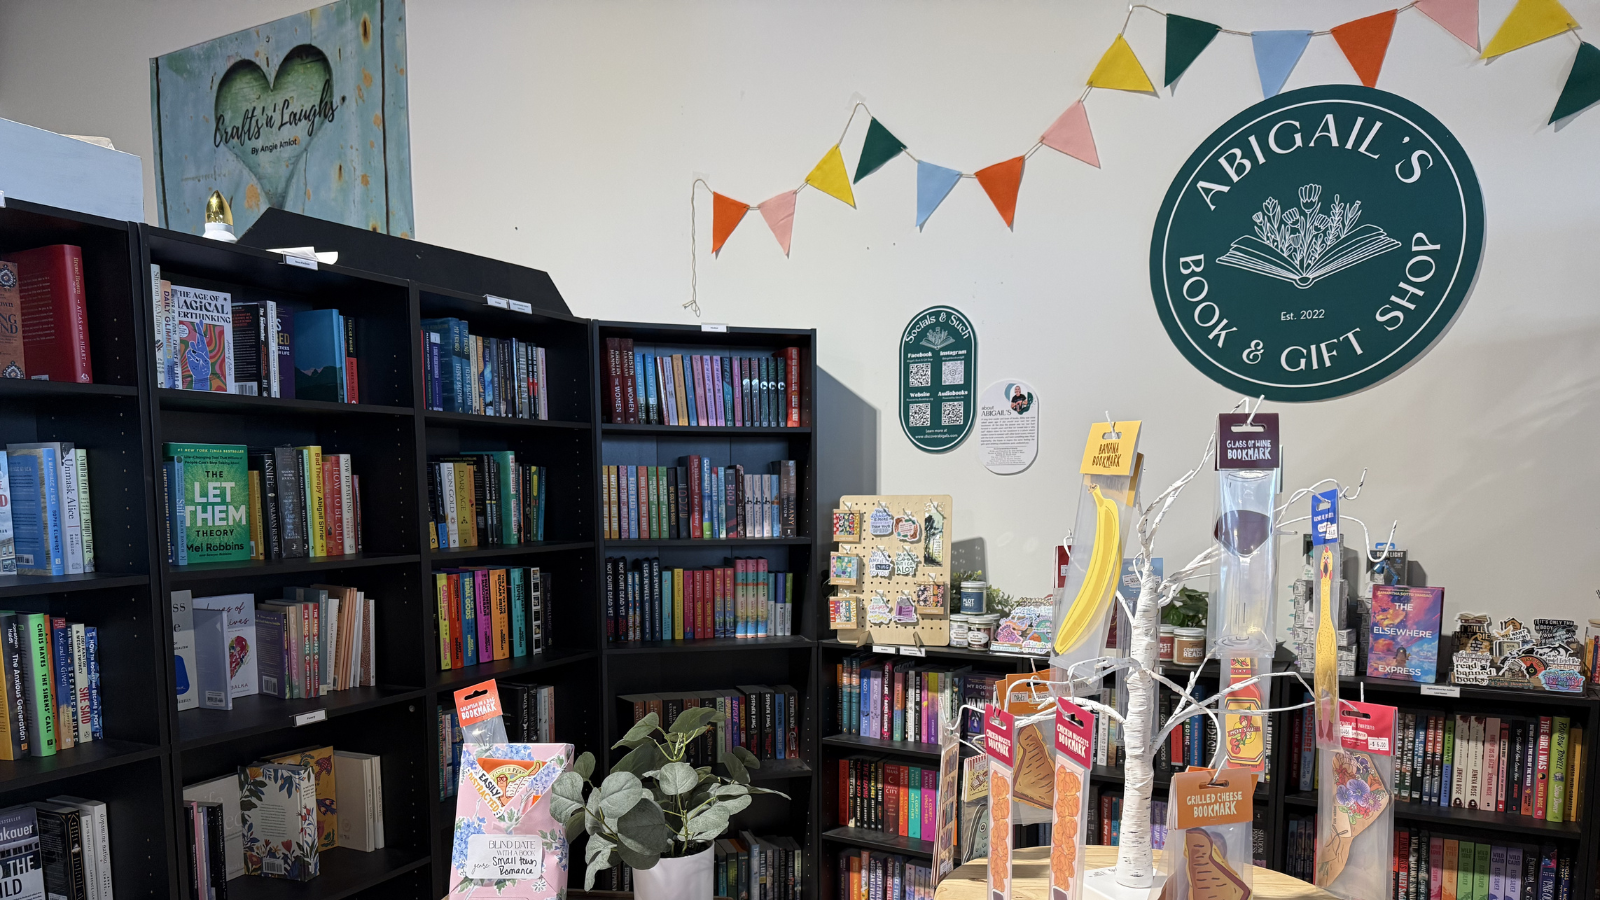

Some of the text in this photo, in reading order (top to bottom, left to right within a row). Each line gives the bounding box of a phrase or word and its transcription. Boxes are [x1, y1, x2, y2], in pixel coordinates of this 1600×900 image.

[251, 146, 259, 155] By
[260, 142, 278, 153] Angie
[1196, 113, 1433, 211] ABIGAIL'S
[163, 290, 171, 313] DAILY
[190, 292, 220, 303] AGE OF
[1178, 231, 1441, 372] BOOK & GIFT SHOP
[177, 311, 231, 324] ERTHINKING
[1280, 309, 1325, 321] Est. 2022
[905, 312, 970, 344] Socials & Such
[940, 349, 967, 357] Instagram
[519, 358, 527, 378] HELL
[614, 385, 622, 413] WOMEN
[1098, 442, 1120, 456] BANANA
[1226, 439, 1272, 449] GLASS OF WINE
[1091, 453, 1122, 468] BOOKMARK
[1227, 447, 1272, 461] BOOKMARK
[265, 459, 275, 488] KNIFE
[315, 466, 323, 494] Therapy
[333, 467, 341, 489] HOW
[458, 470, 466, 493] DARK
[64, 458, 76, 520] Unmask Alice
[194, 481, 236, 503] LET
[447, 466, 456, 513] IRON GOLD
[334, 494, 341, 506] TO
[184, 504, 247, 527] THEM
[335, 508, 342, 520] BE
[196, 529, 234, 537] THEORY
[186, 542, 244, 553] Mel Robbins
[1395, 602, 1414, 611] THE
[1373, 626, 1433, 638] ELSEWHERE
[1467, 625, 1485, 633] WILL
[37, 623, 45, 644] CHRIS
[42, 688, 51, 713] SIRENS'
[1378, 664, 1422, 676] EXPRESS
[1456, 668, 1493, 676] banned
[12, 653, 27, 741] The Anxious Generation
[78, 686, 91, 725] SHE SAID
[461, 702, 497, 721] BOOKMARK
[1056, 723, 1090, 747] CHICKEN NUGGETS
[1540, 720, 1550, 733] THE
[1557, 721, 1567, 748] RAINBOW
[1058, 732, 1086, 759] BOOKMARK
[1206, 719, 1216, 756] GIDEON
[1539, 734, 1549, 750] GIRL
[1538, 755, 1548, 770] WAS
[478, 773, 501, 797] EASILY
[1455, 767, 1465, 795] JENEVA ROSE
[1470, 769, 1479, 797] JENEVA ROSE
[467, 772, 500, 812] DISTRACTED
[1186, 791, 1243, 806] GRILLED CHEESE
[1193, 801, 1237, 818] BOOKMARK
[488, 840, 536, 849] BLIND DATE
[7, 855, 34, 877] THE
[492, 856, 537, 867] Small town
[499, 865, 534, 876] Romance
